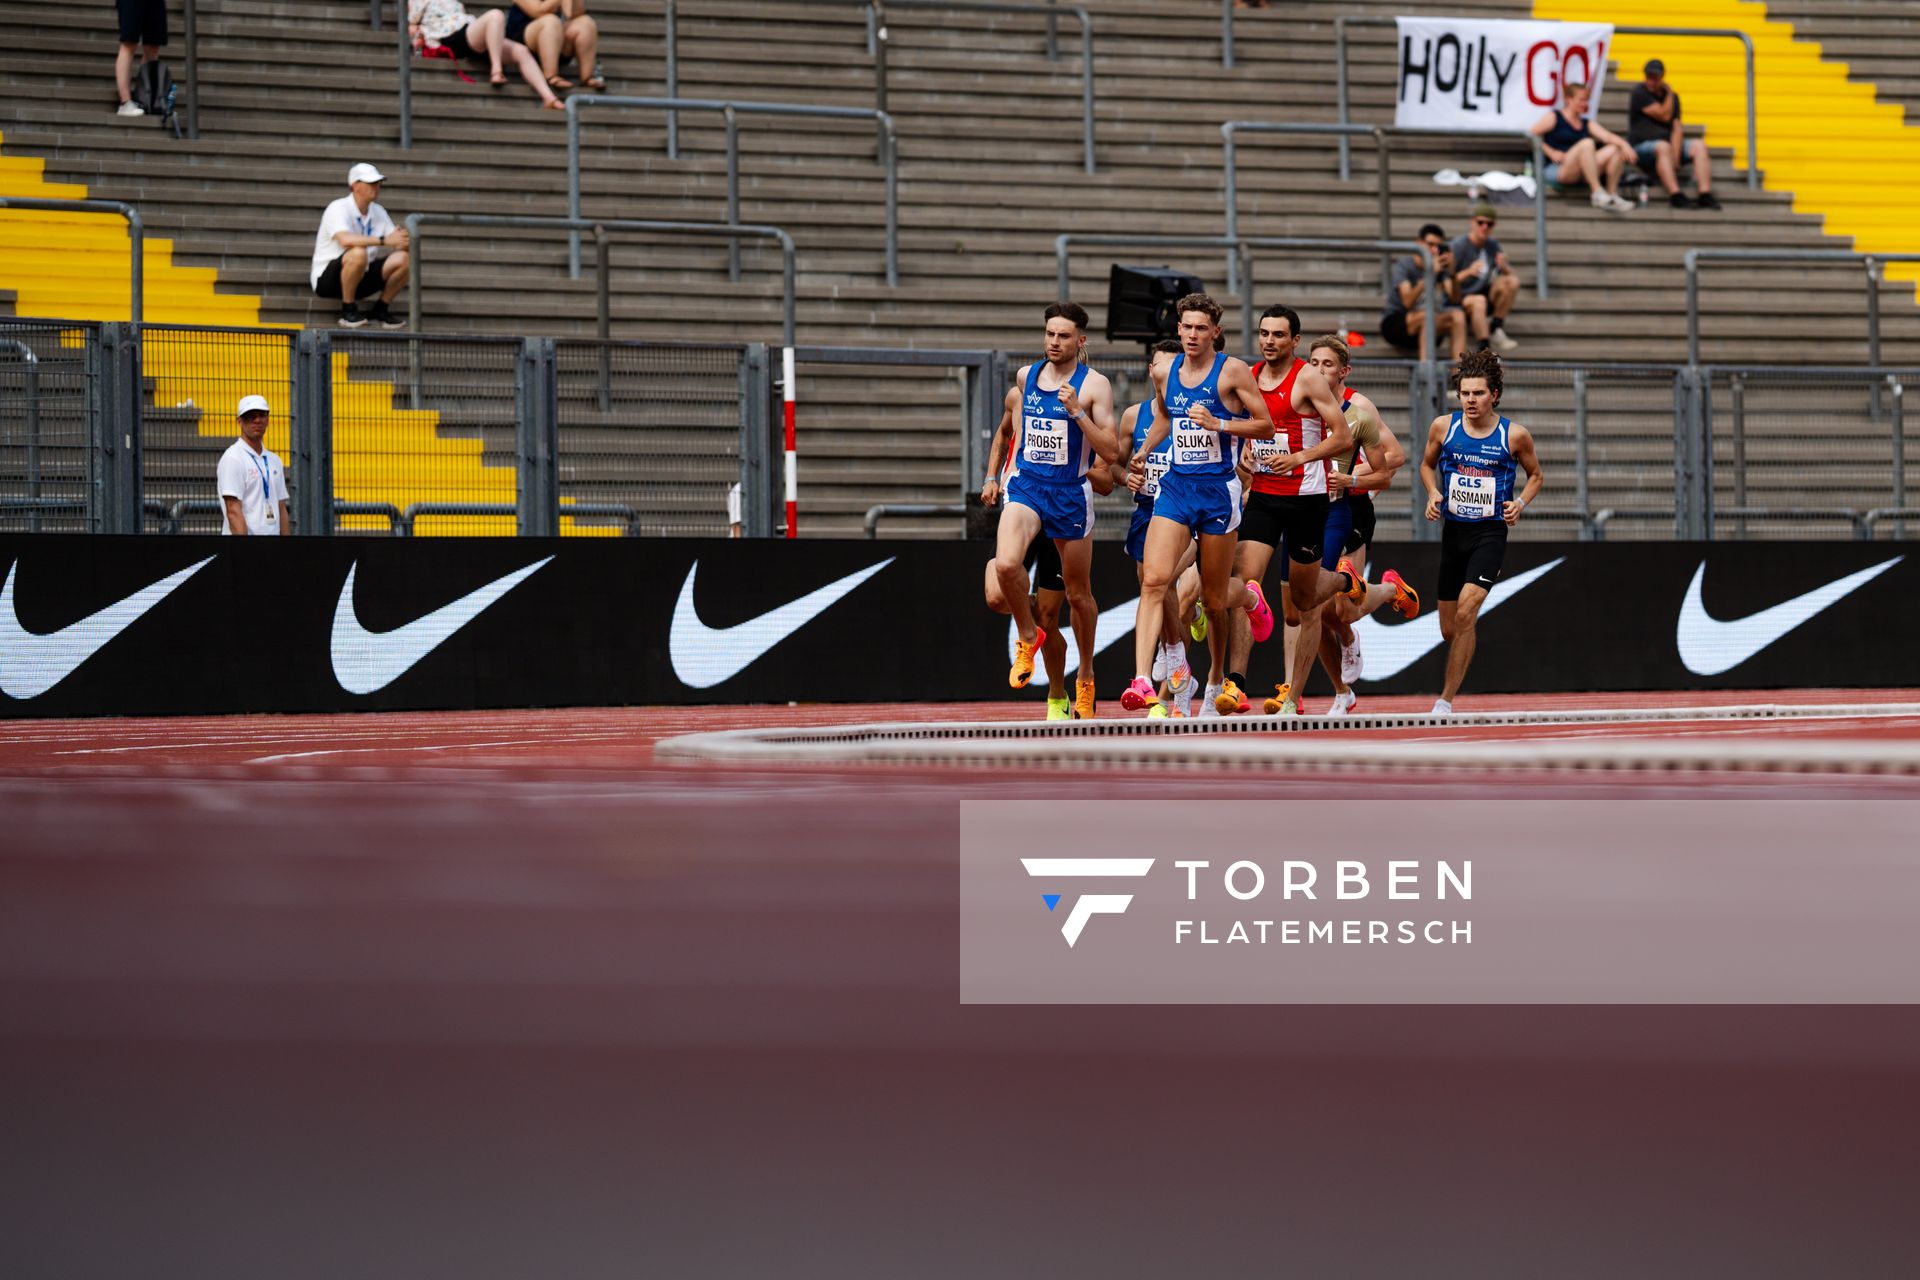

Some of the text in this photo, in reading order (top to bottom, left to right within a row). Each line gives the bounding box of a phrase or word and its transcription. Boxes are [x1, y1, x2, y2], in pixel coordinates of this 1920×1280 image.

[1400, 32, 1517, 114] HOLLY
[1027, 433, 1064, 449] PROBST
[1177, 435, 1214, 448] SLUKA
[1464, 454, 1499, 466] Villingen
[1451, 489, 1493, 505] ASSMANN
